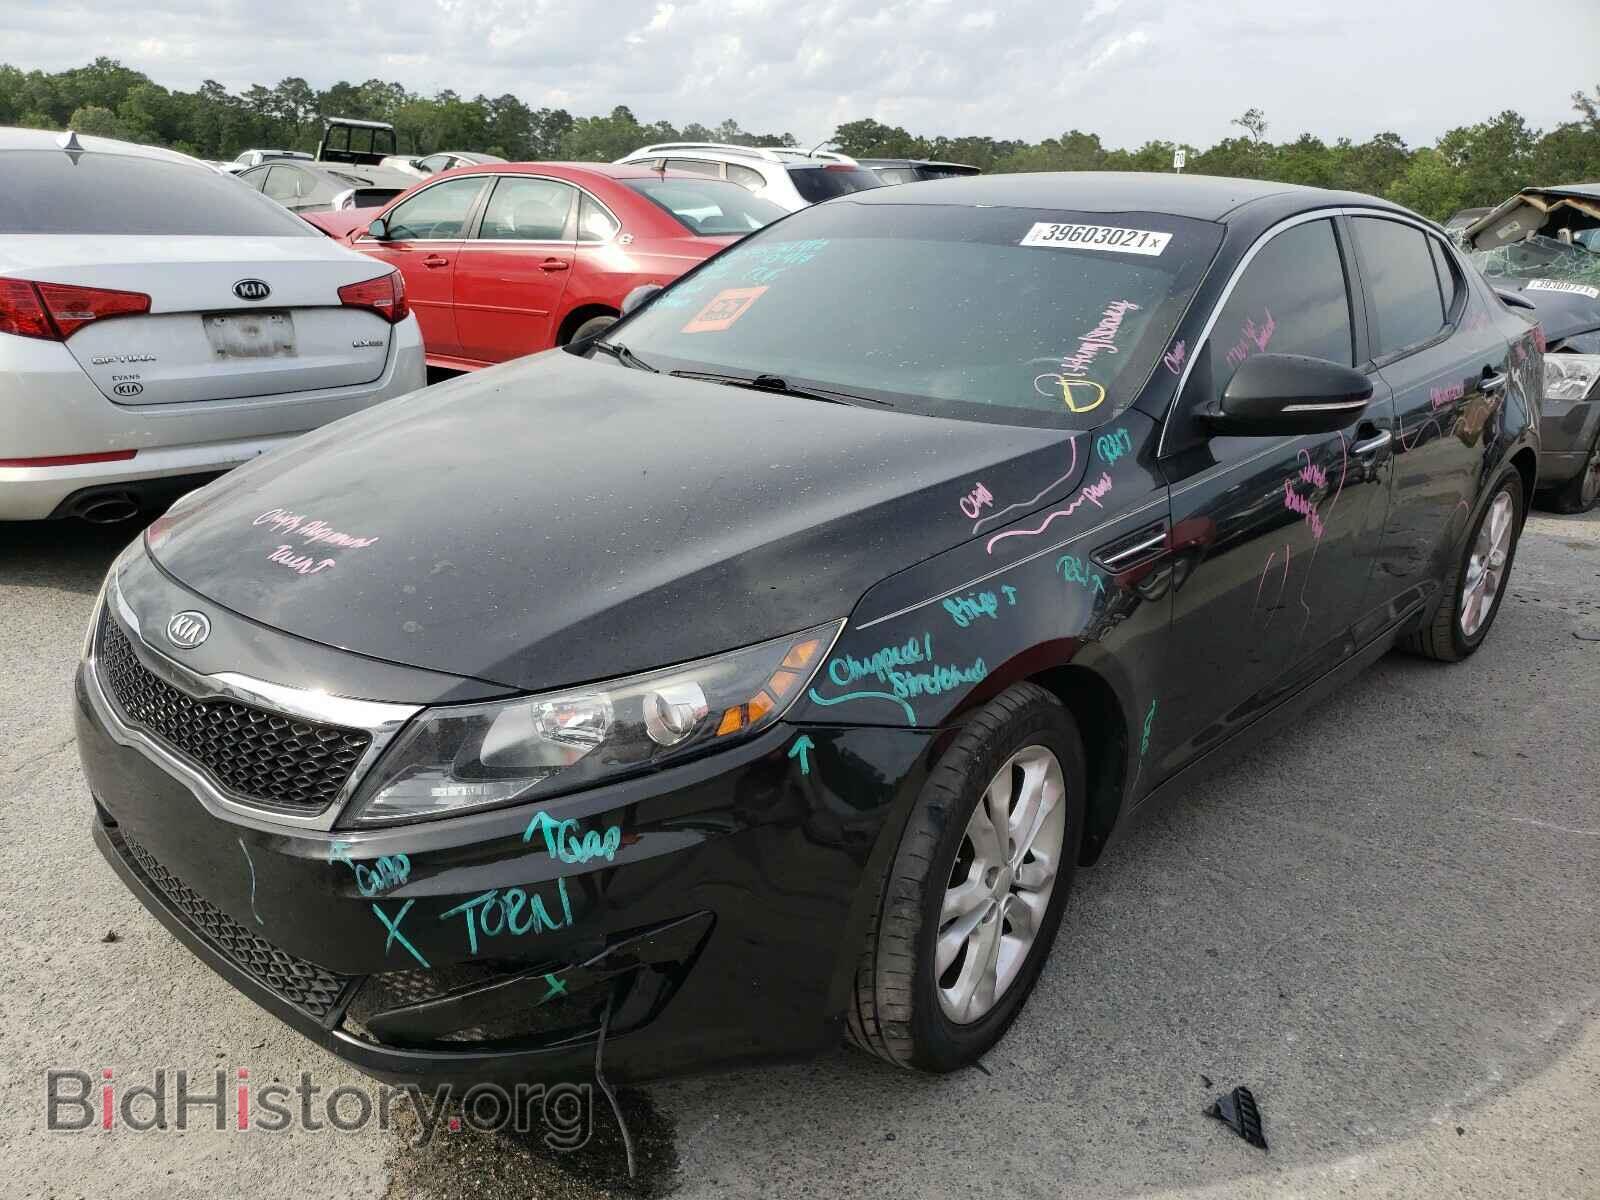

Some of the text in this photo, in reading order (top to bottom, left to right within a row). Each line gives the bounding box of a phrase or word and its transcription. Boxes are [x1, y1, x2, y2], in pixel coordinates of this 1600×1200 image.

[1043, 225, 1150, 248] 39603021
[239, 283, 267, 296] KIA
[91, 354, 156, 365] OPTIMA
[171, 615, 202, 643] KIA
